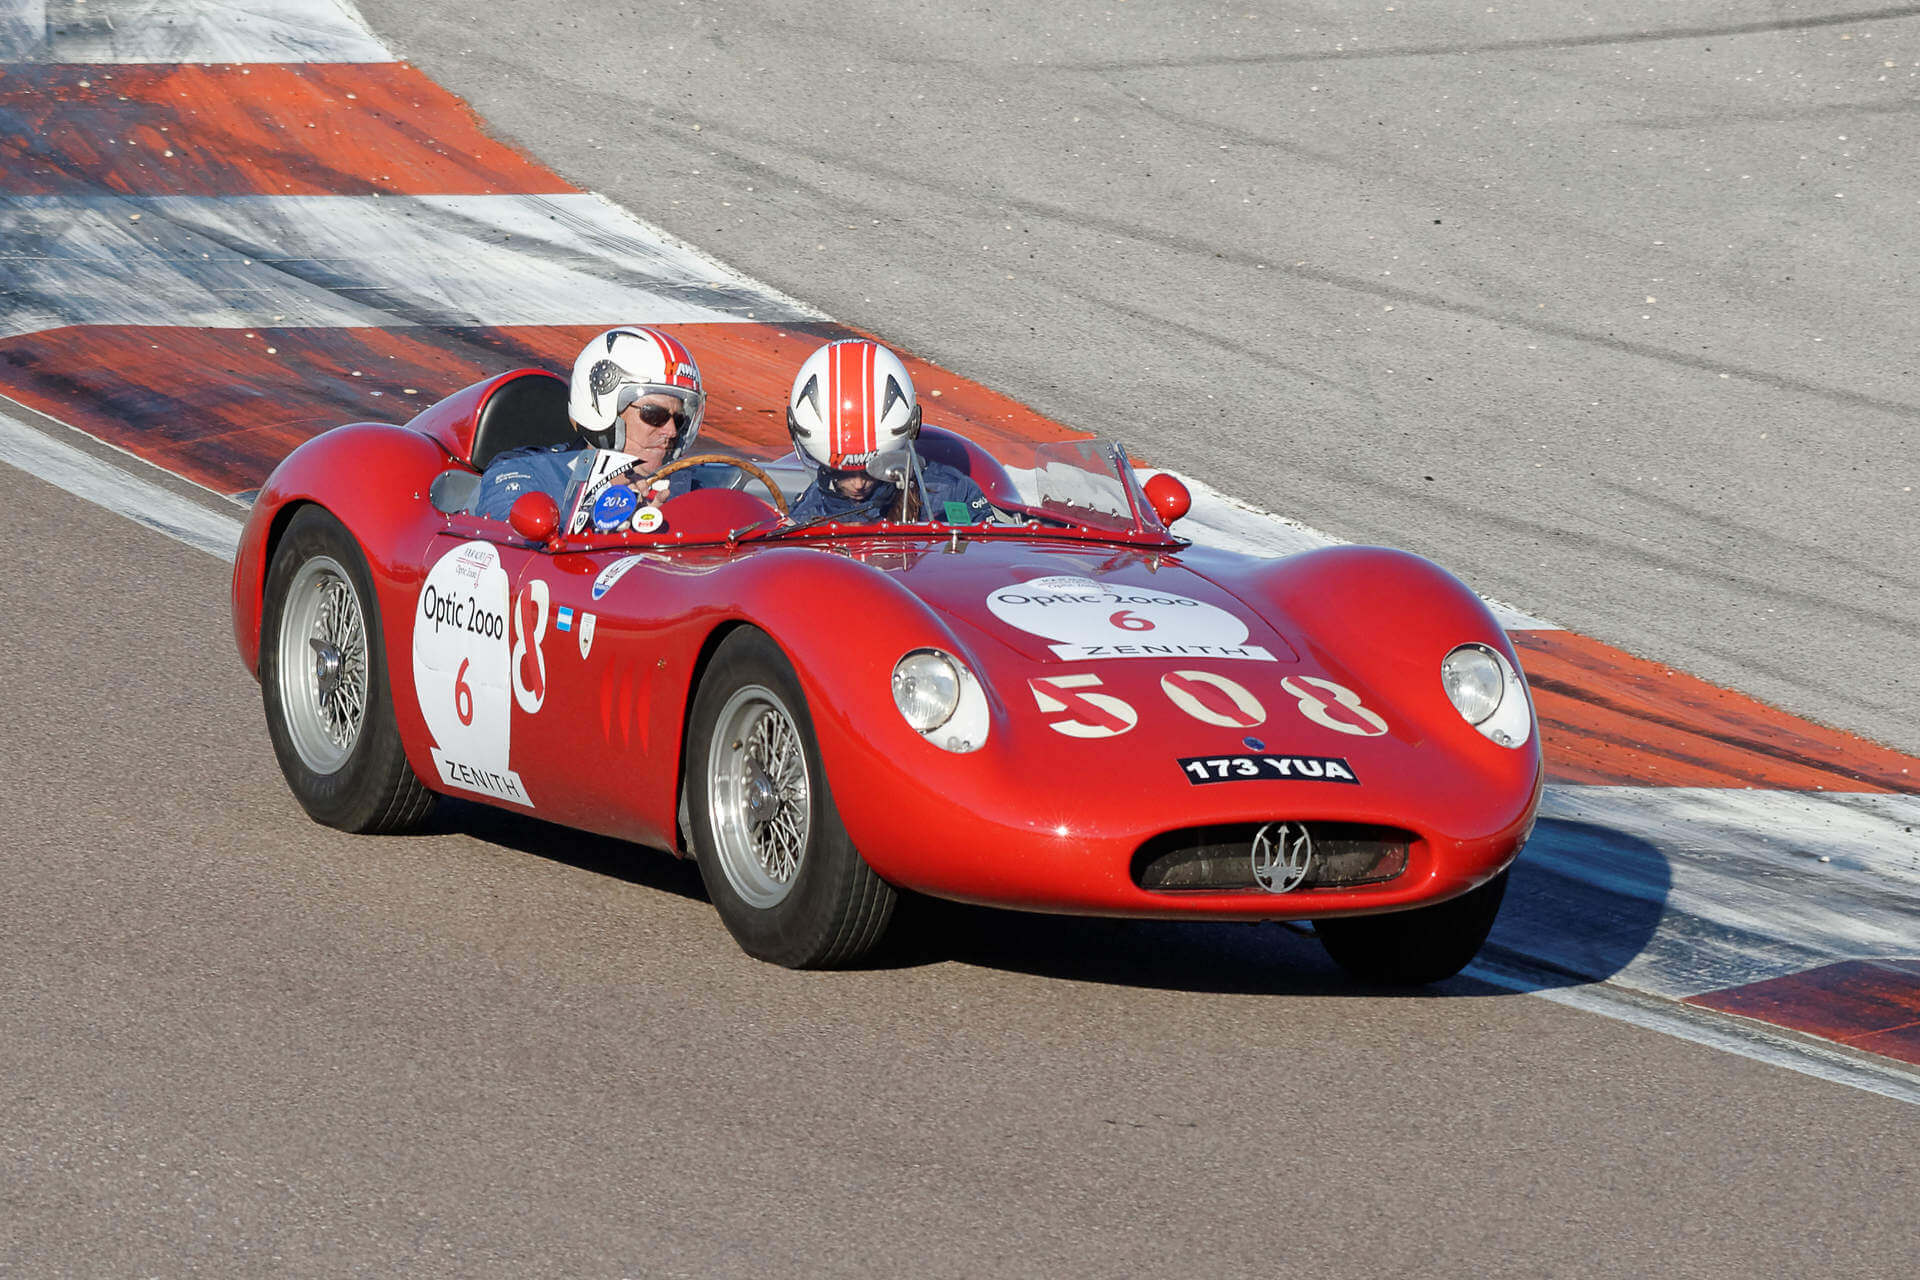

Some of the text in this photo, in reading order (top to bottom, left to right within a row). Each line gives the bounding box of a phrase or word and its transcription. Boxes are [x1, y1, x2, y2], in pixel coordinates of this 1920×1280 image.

[603, 496, 628, 507] 2015
[998, 592, 1200, 607] Optic 2000
[424, 585, 503, 640] Optic 2000
[1109, 610, 1155, 631] 6
[512, 579, 549, 714] 8
[1081, 645, 1250, 656] ZENITH
[455, 657, 473, 726] 6
[446, 760, 520, 797] ZENITH
[1186, 758, 1354, 780] 173 YUA
